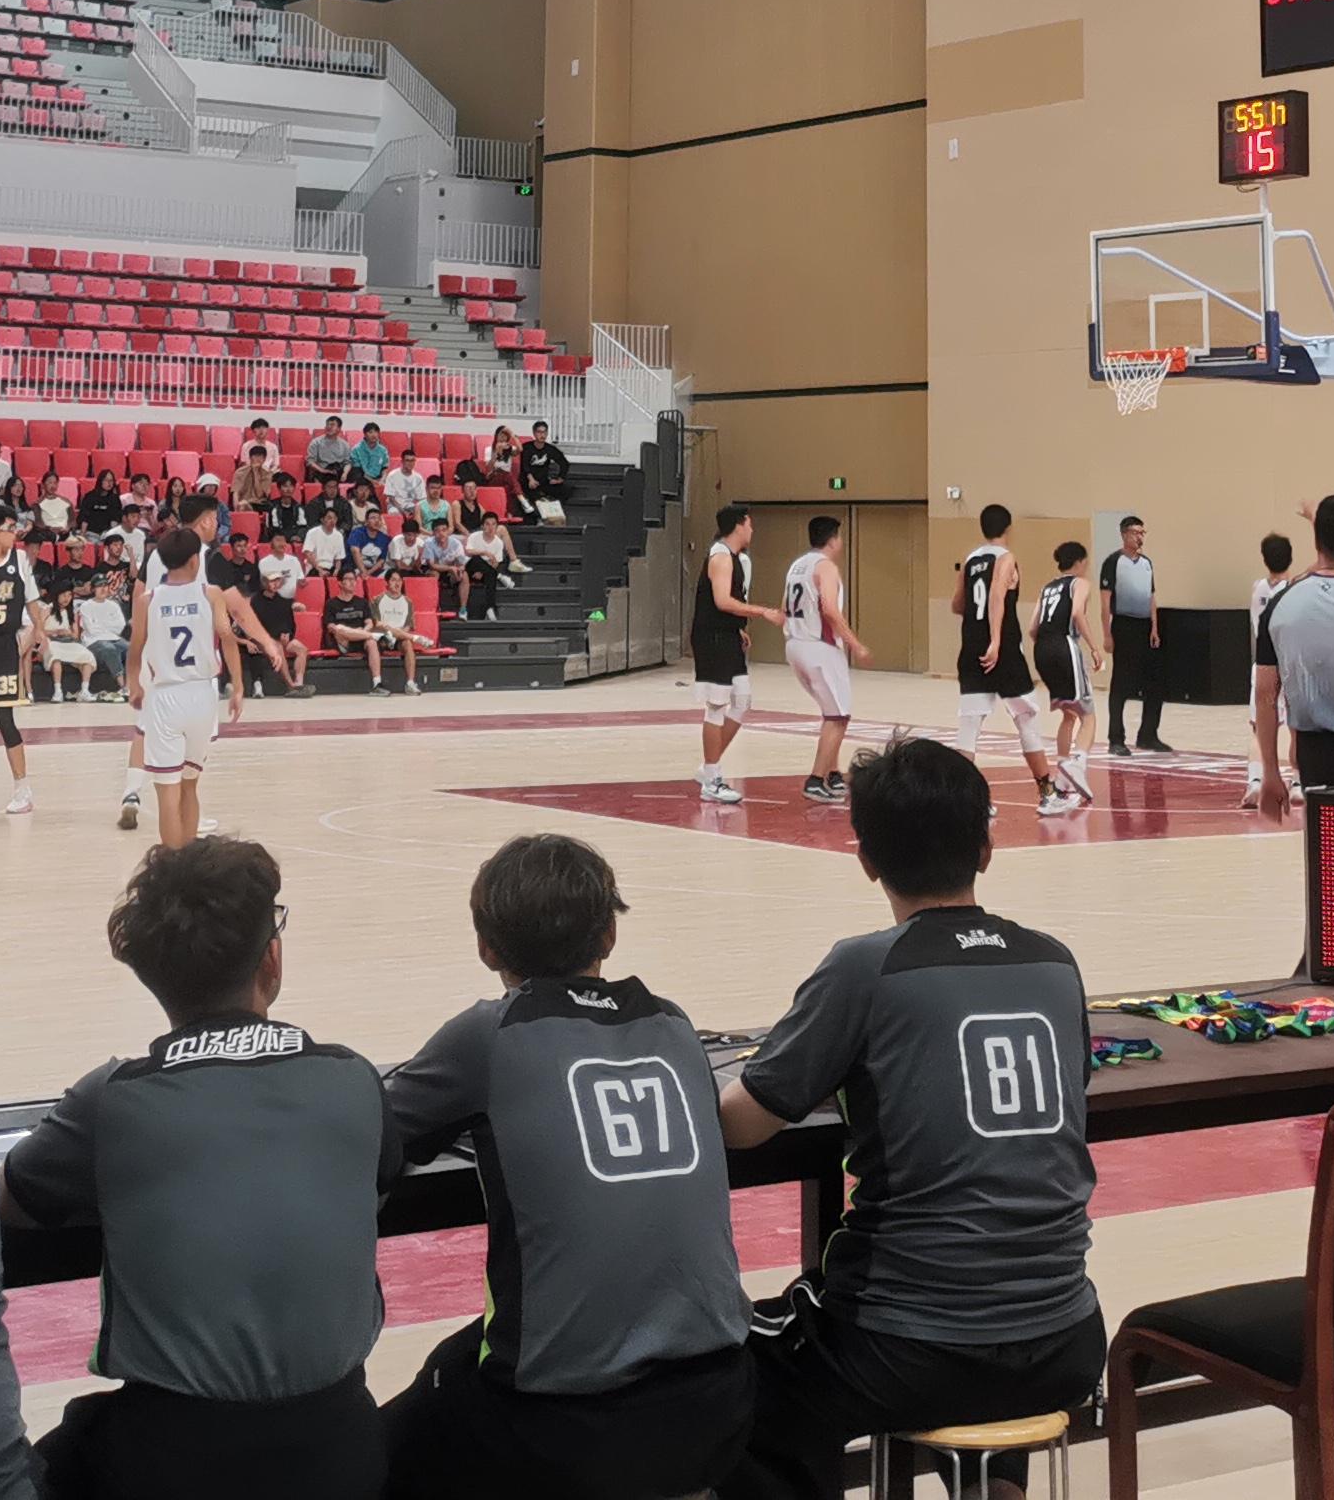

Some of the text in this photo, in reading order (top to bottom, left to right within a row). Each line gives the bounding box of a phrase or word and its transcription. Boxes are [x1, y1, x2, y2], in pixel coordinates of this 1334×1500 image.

[1248, 130, 1274, 171] 15
[973, 578, 986, 620] 9
[170, 626, 195, 667] 2
[982, 1034, 1047, 1116] 81
[593, 1077, 669, 1158] 67
